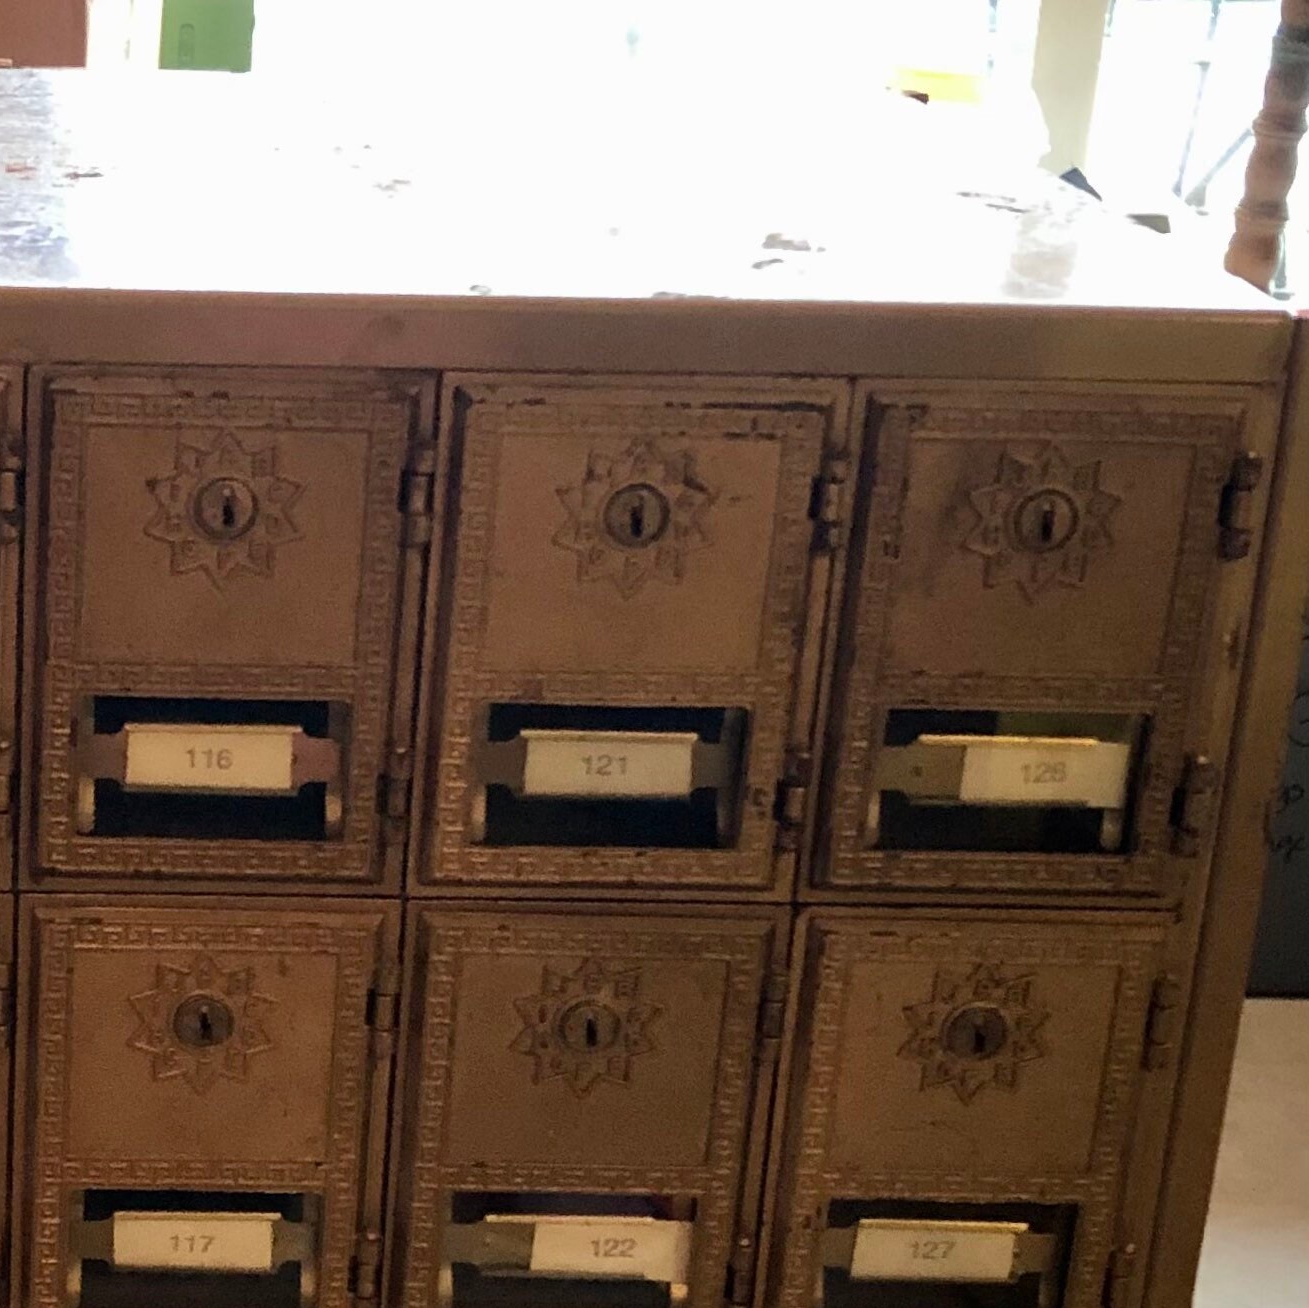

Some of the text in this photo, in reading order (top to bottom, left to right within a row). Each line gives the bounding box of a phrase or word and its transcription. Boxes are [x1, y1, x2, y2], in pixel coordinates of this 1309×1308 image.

[186, 749, 233, 769] 116
[581, 755, 628, 776] 121
[170, 1234, 216, 1254] 117
[591, 1238, 637, 1258] 122
[908, 1240, 957, 1260] 127
